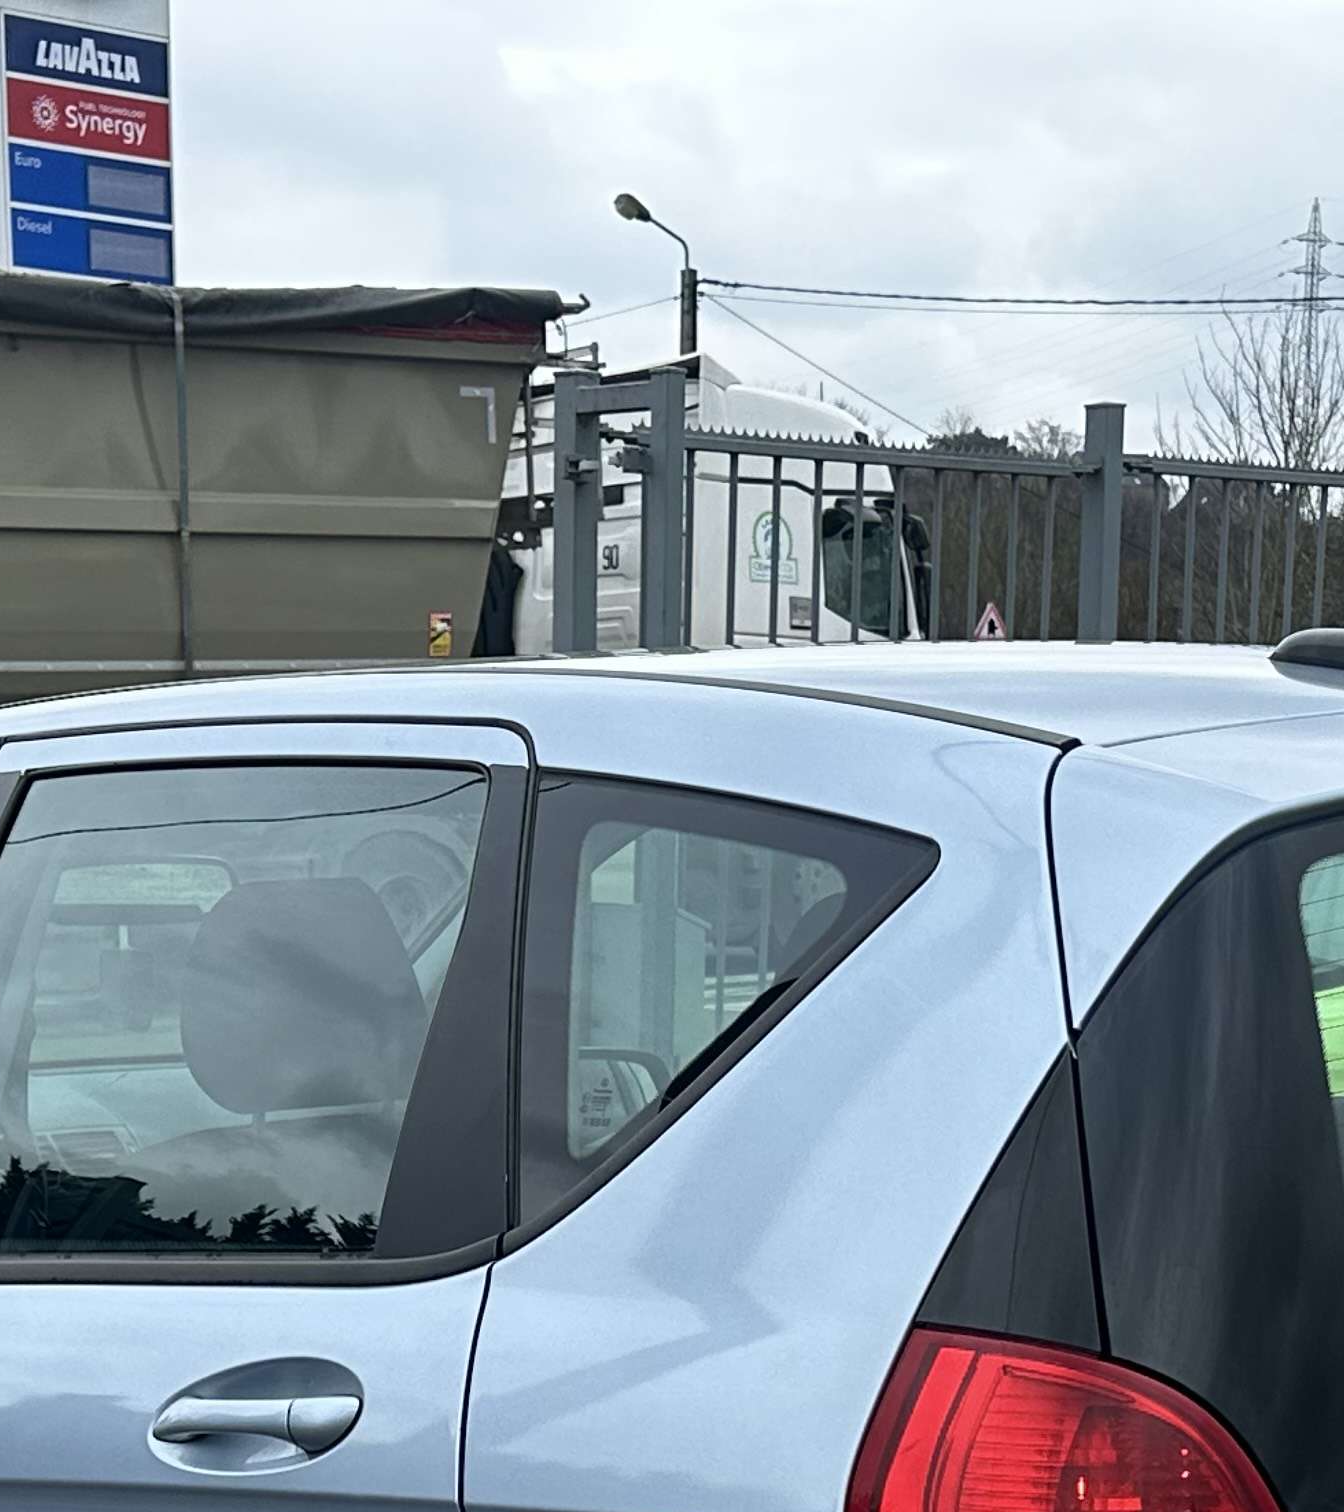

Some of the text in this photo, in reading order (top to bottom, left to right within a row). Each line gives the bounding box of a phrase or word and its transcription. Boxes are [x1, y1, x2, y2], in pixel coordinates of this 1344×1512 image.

[35, 37, 141, 84] LAVAZZA
[64, 104, 148, 146] Synergy
[14, 151, 43, 169] Euro
[16, 215, 53, 236] Diesel
